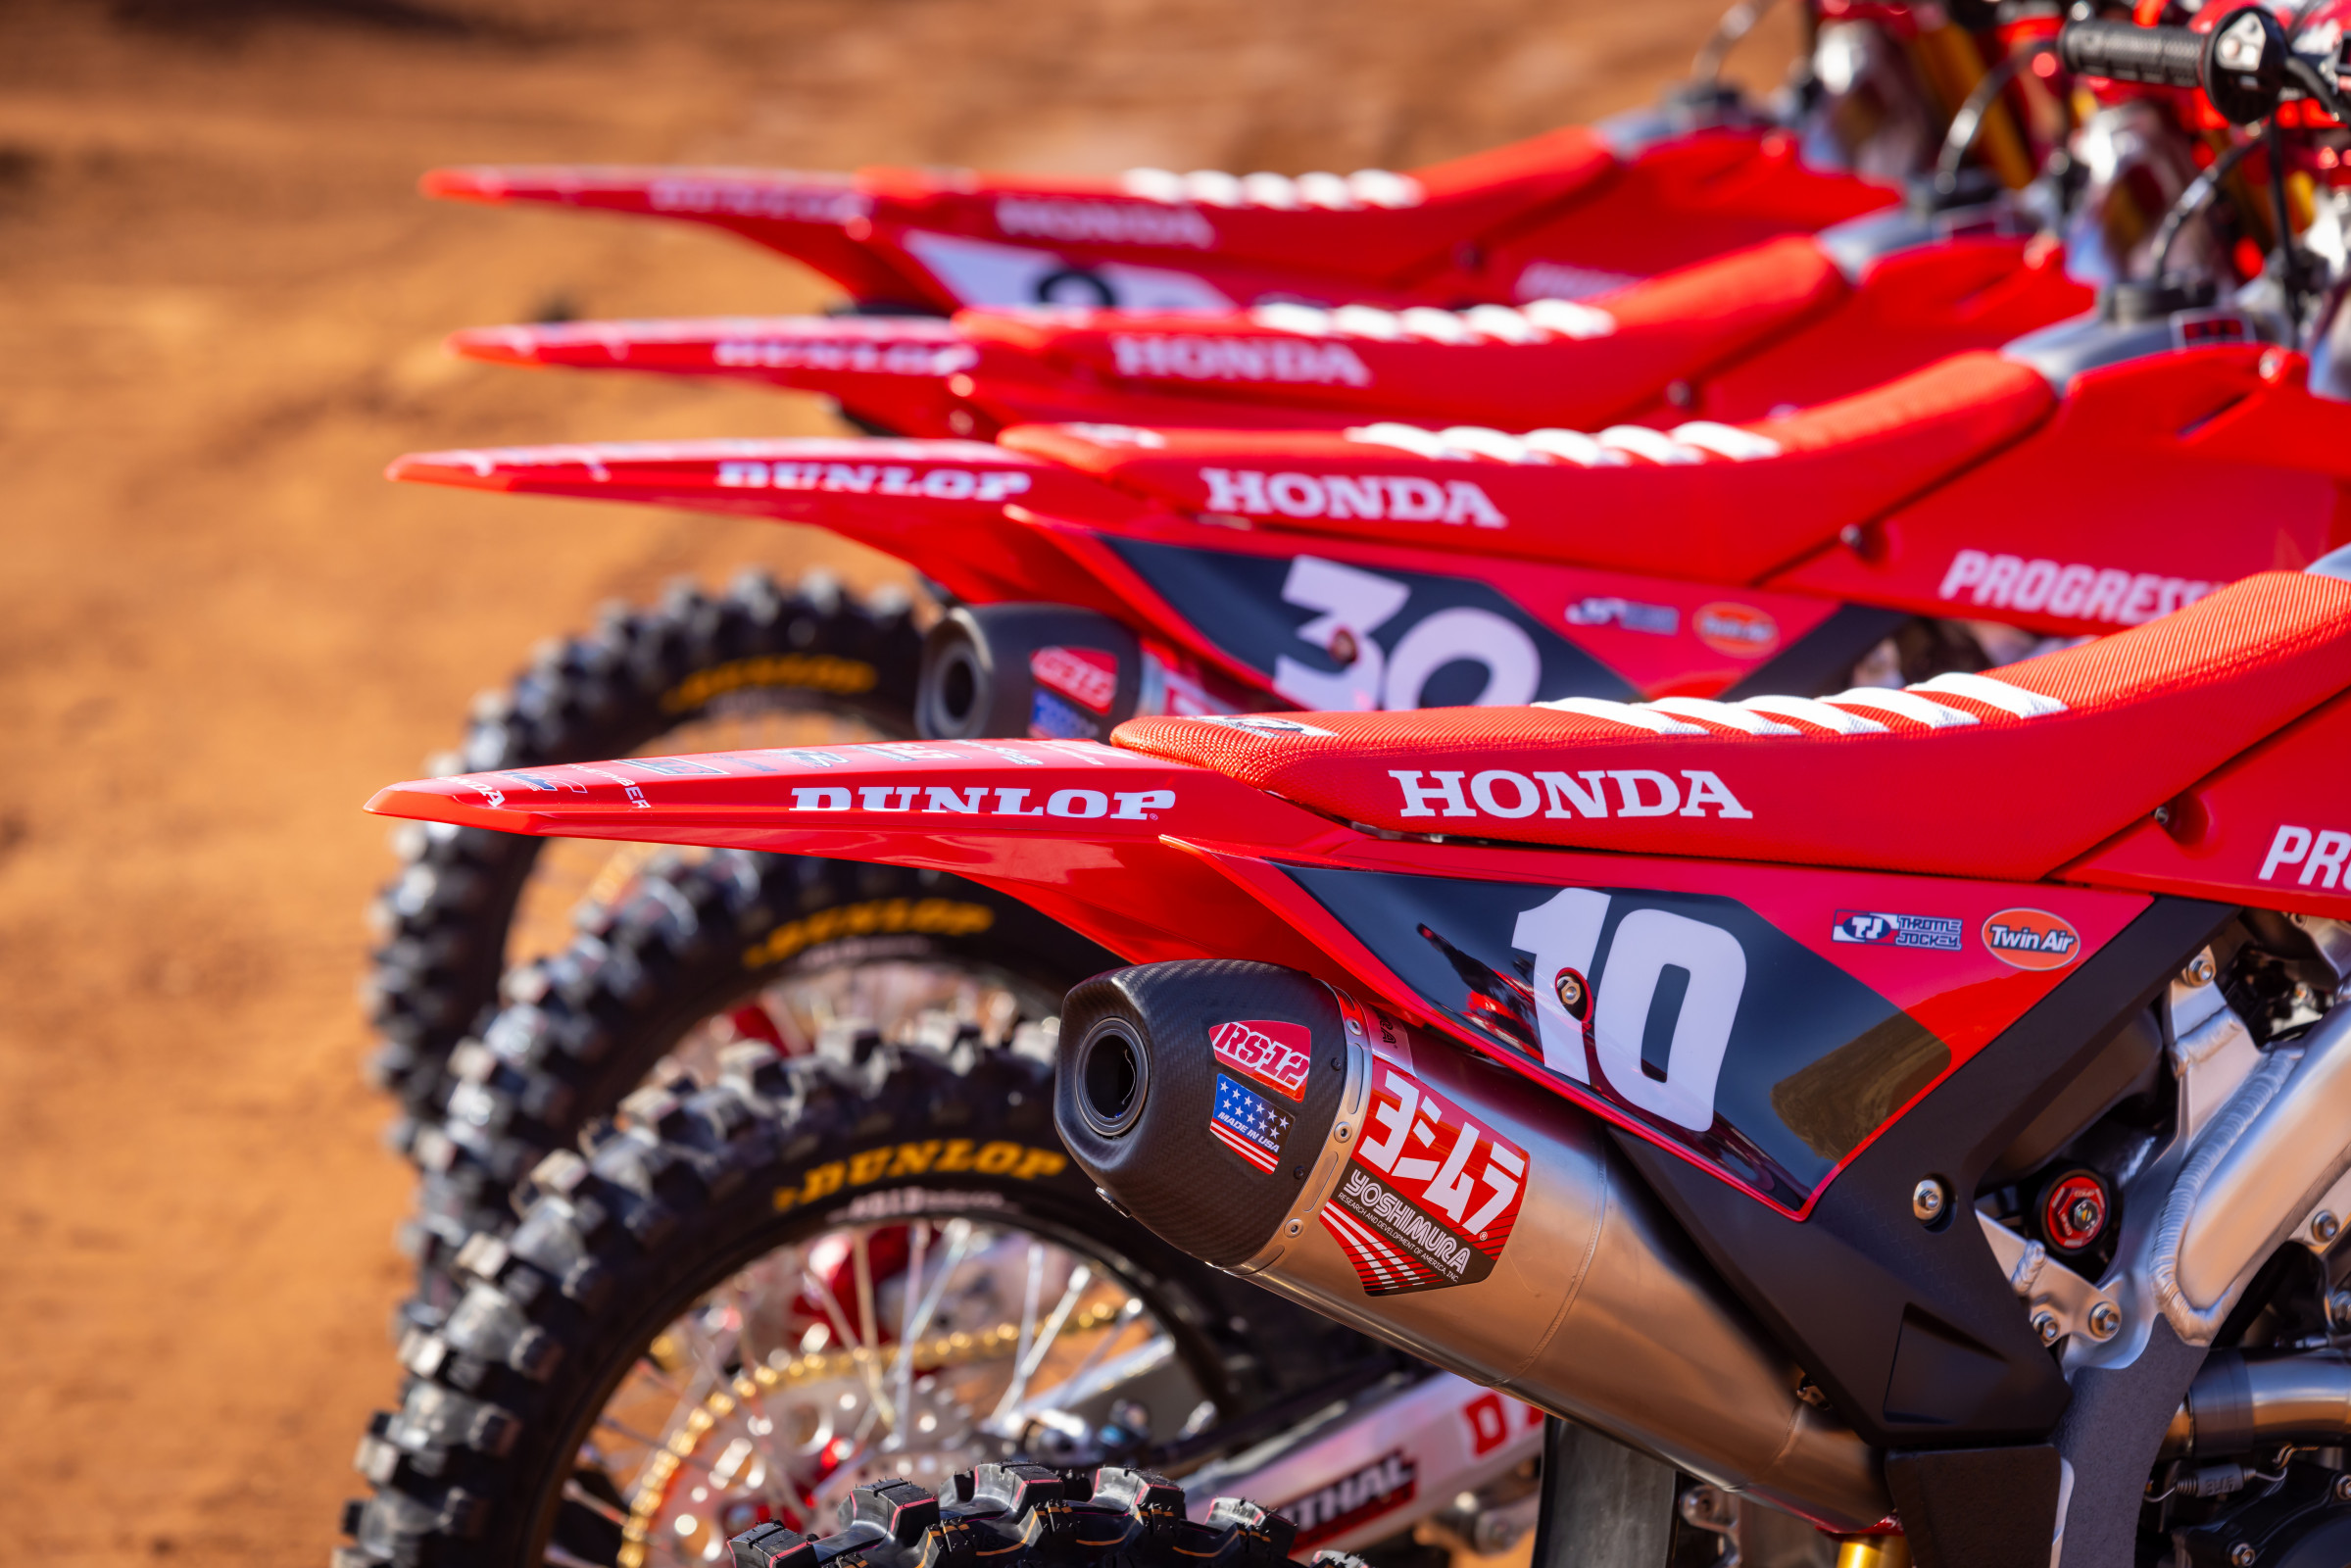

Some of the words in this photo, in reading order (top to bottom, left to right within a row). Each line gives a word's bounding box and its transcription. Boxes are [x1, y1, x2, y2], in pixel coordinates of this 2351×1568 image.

[1113, 335, 1372, 387] HONDA
[716, 461, 1031, 502] DUNLOP
[1200, 466, 1507, 528] HONDA
[1274, 554, 1541, 710] 30
[436, 777, 506, 808] ONDA
[789, 786, 1176, 820] DUNLOP
[1388, 769, 1753, 819] HONDA
[2258, 824, 2351, 892] PR
[1895, 932, 1963, 952] JOCKEY
[1898, 913, 1963, 934] THROTTLE
[1990, 925, 2039, 950] Twin
[2039, 931, 2075, 953] Air
[1511, 887, 1746, 1132] 10
[1217, 1110, 1249, 1135] MADE
[1248, 1128, 1259, 1140] IN
[1258, 1134, 1280, 1153] USA
[798, 1138, 1068, 1203] DUNLOP
[1338, 1192, 1367, 1217] RESEARCH
[1365, 1212, 1379, 1225] AND
[1377, 1220, 1415, 1251] DEVELOPMENT
[1413, 1247, 1423, 1255] OF
[1445, 1270, 1458, 1283] INC.
[1343, 1168, 1471, 1275] YOSHIMURA
